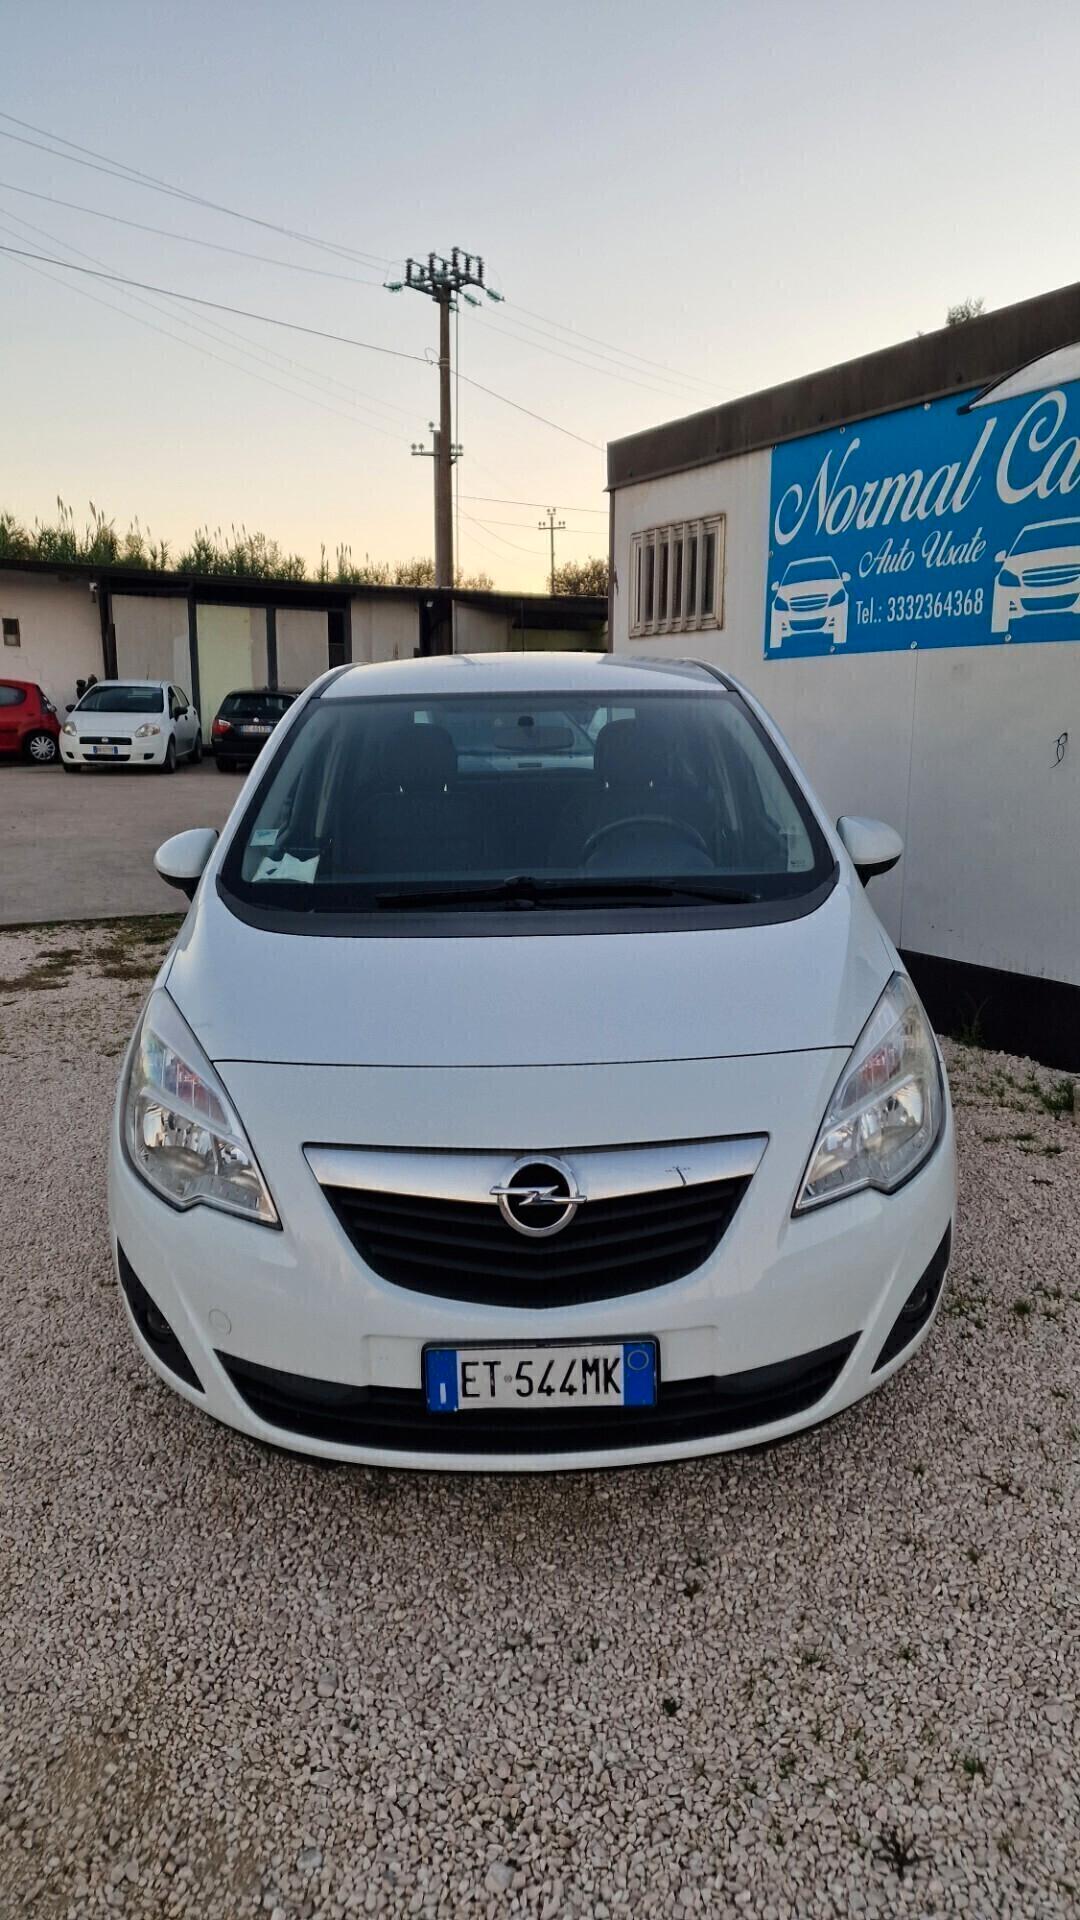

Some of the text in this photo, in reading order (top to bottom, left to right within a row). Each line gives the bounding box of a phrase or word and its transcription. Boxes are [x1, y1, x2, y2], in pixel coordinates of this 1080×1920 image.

[774, 417, 997, 545] Normal
[858, 526, 987, 578] Auto Usate
[886, 587, 984, 622] 3332364368
